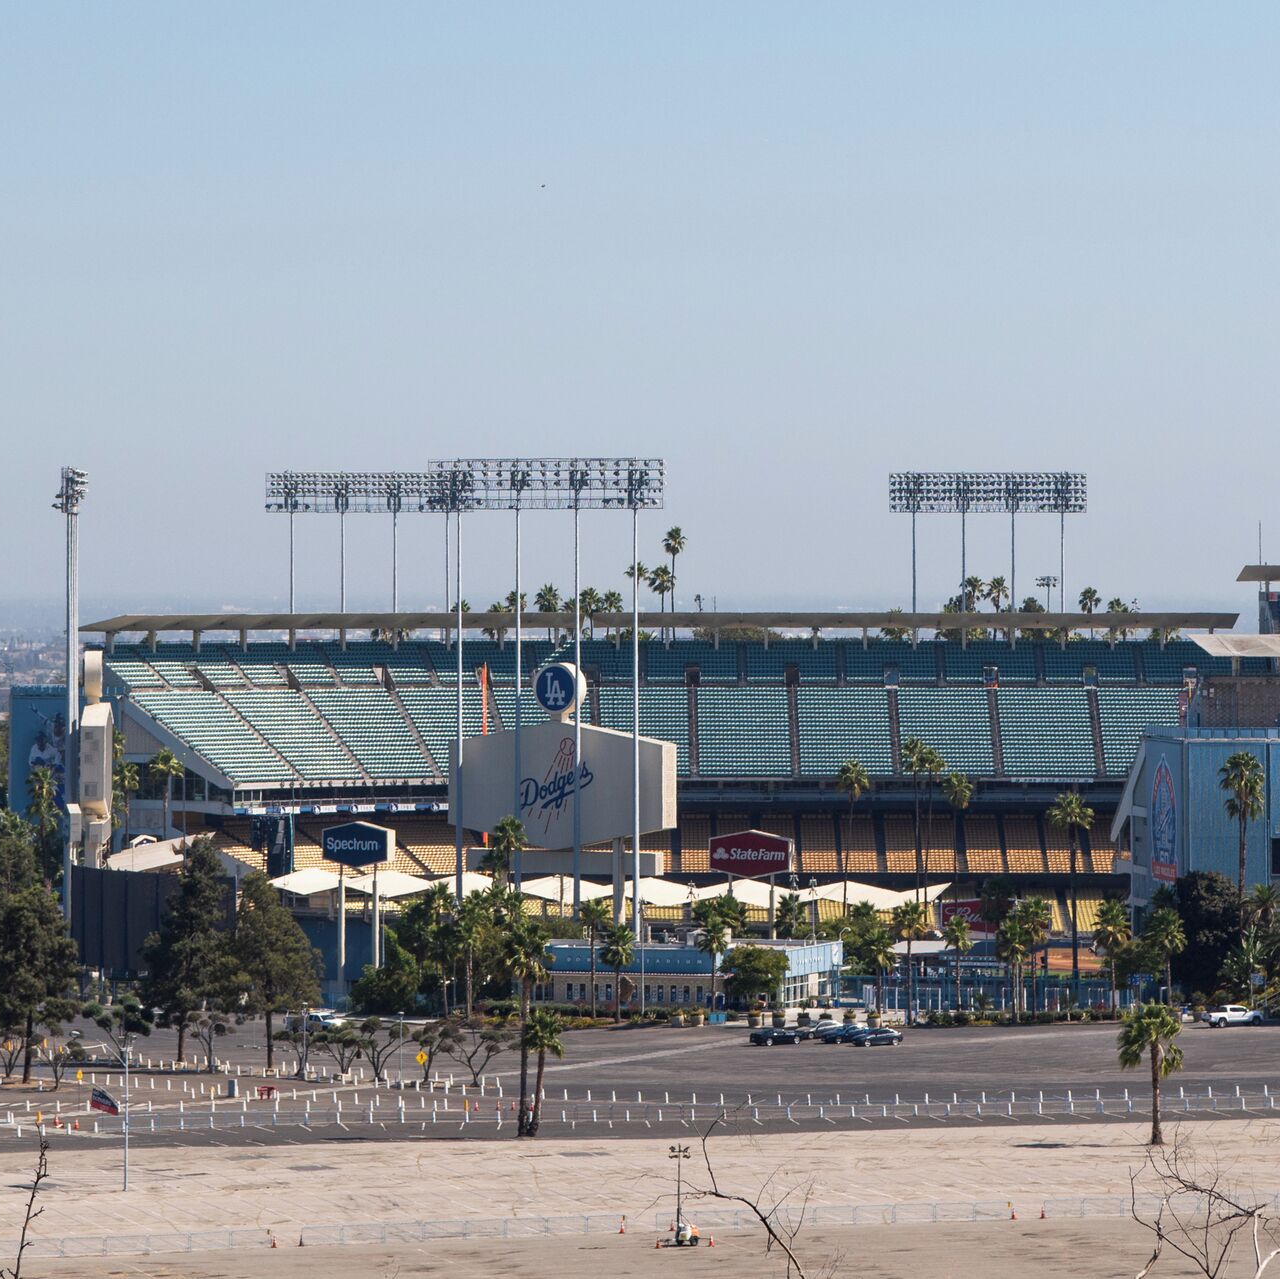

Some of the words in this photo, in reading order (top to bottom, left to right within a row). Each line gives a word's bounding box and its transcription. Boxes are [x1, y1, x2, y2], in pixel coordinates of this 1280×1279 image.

[545, 672, 565, 705] LA
[520, 761, 594, 810] Dodges
[326, 837, 378, 852] Spectrum
